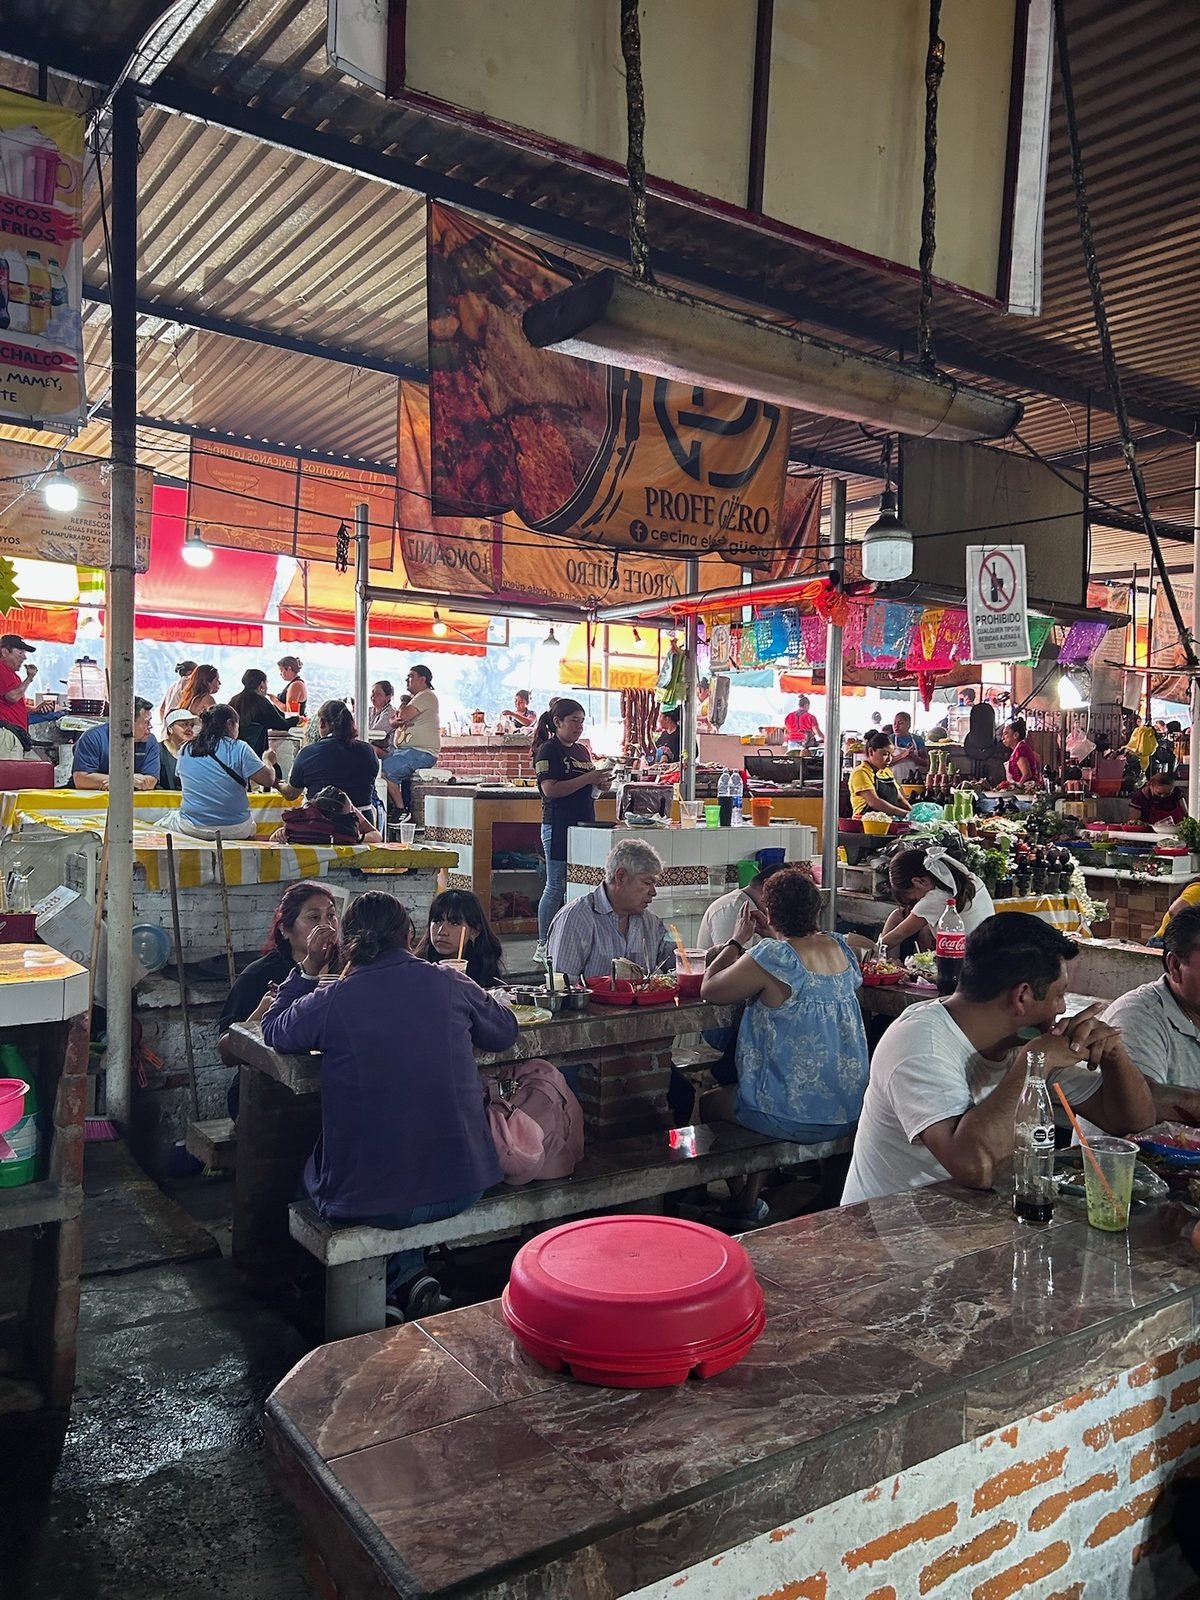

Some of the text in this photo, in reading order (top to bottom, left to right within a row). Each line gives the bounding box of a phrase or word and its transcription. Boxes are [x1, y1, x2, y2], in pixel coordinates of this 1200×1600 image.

[1, 218, 57, 241] FRIOS
[644, 486, 715, 525] PROFE
[63, 524, 85, 533] AGUAS
[650, 528, 697, 546] cecina
[975, 612, 1021, 625] PROHIBIDO
